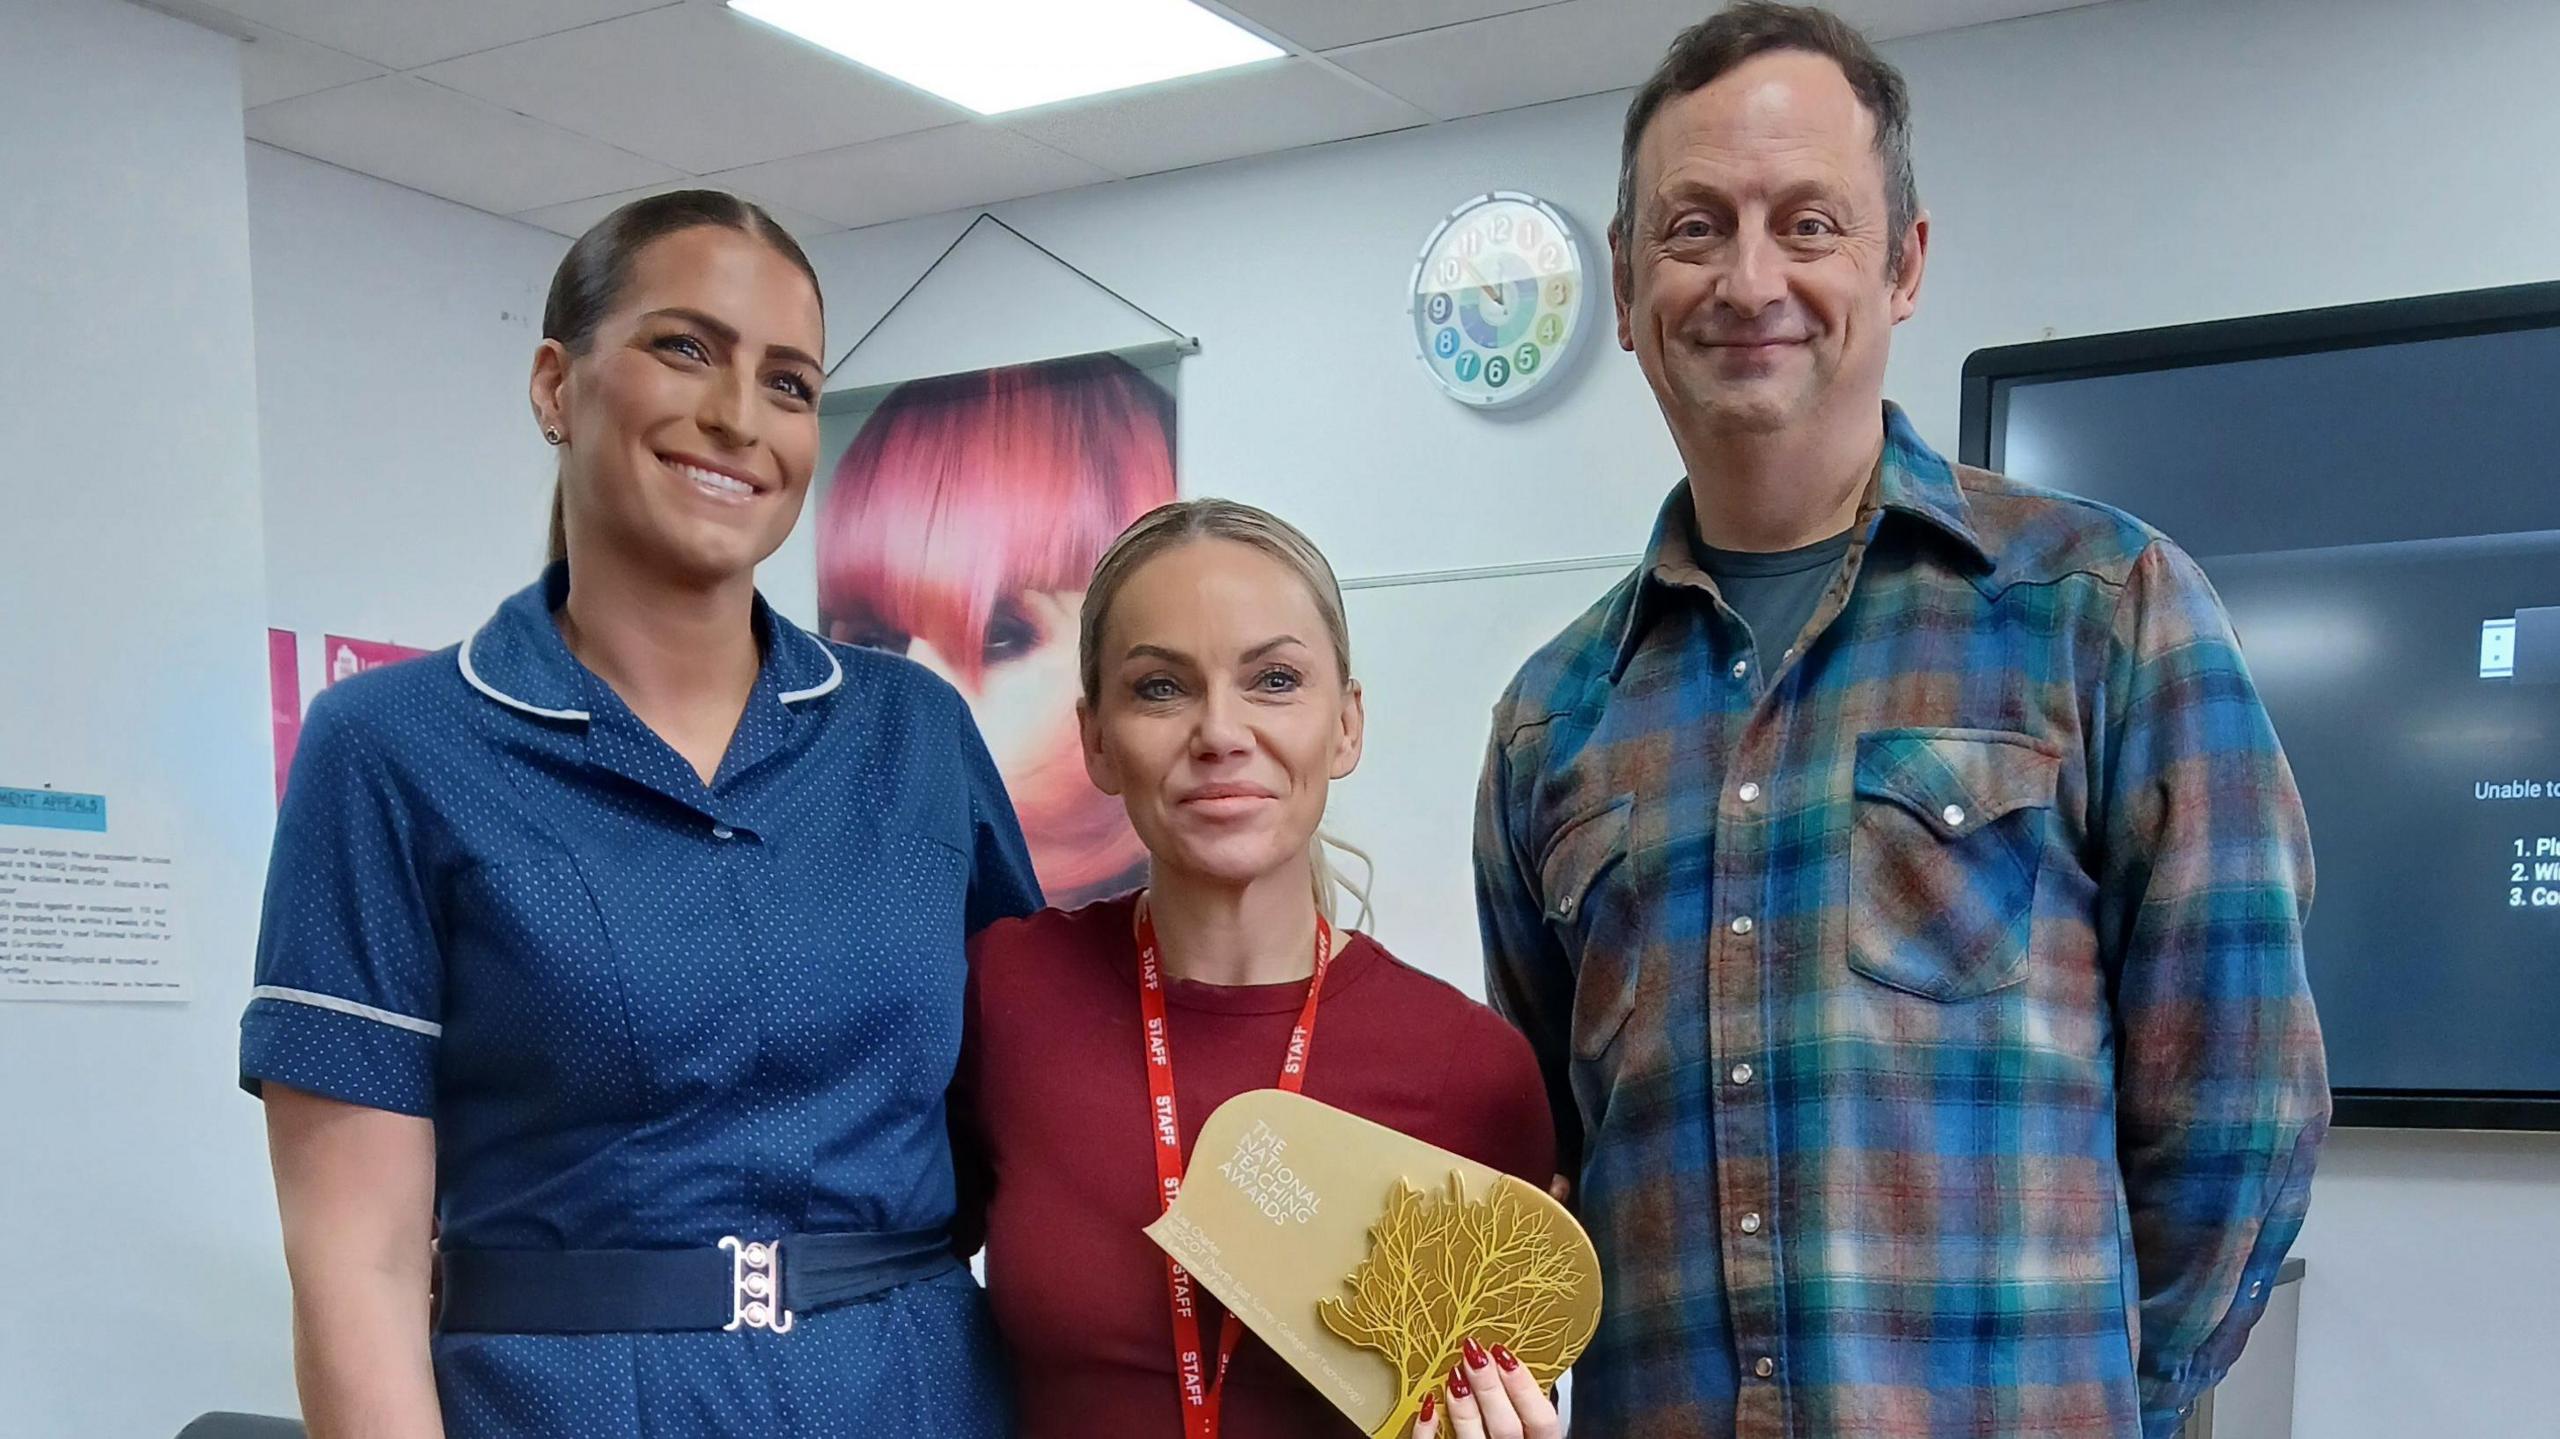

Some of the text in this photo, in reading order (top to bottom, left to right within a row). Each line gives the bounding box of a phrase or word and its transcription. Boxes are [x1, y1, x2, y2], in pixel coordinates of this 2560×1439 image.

[1489, 216, 1509, 242] 12
[1462, 231, 1477, 254] 11
[1544, 246, 1556, 268] 2
[1439, 258, 1459, 284] 10
[1433, 295, 1446, 317] 9
[1553, 284, 1567, 305] 3
[1543, 318, 1556, 342] 4
[1440, 332, 1453, 354] 8
[1460, 354, 1473, 377] 7
[1519, 346, 1532, 370] 5
[1488, 360, 1501, 382] 6
[2475, 779, 2541, 799] Unable
[42, 797, 97, 813] APPEALS
[2514, 839, 2530, 857] 1.
[2511, 862, 2560, 881] 2. Wi
[2509, 886, 2560, 906] 3. Co
[1142, 946, 1158, 990] STAFF
[1148, 1017, 1167, 1067] STAFF
[1285, 1025, 1308, 1075] STAFF
[1156, 1095, 1175, 1147] STAFF
[1252, 1119, 1288, 1156] THE
[1232, 1145, 1312, 1224] TEACHING
[1240, 1133, 1321, 1214] NATIONAL
[1217, 1162, 1289, 1226] AWARDS
[1173, 1262, 1191, 1318] STAFF
[1183, 1351, 1203, 1407] STAFF
